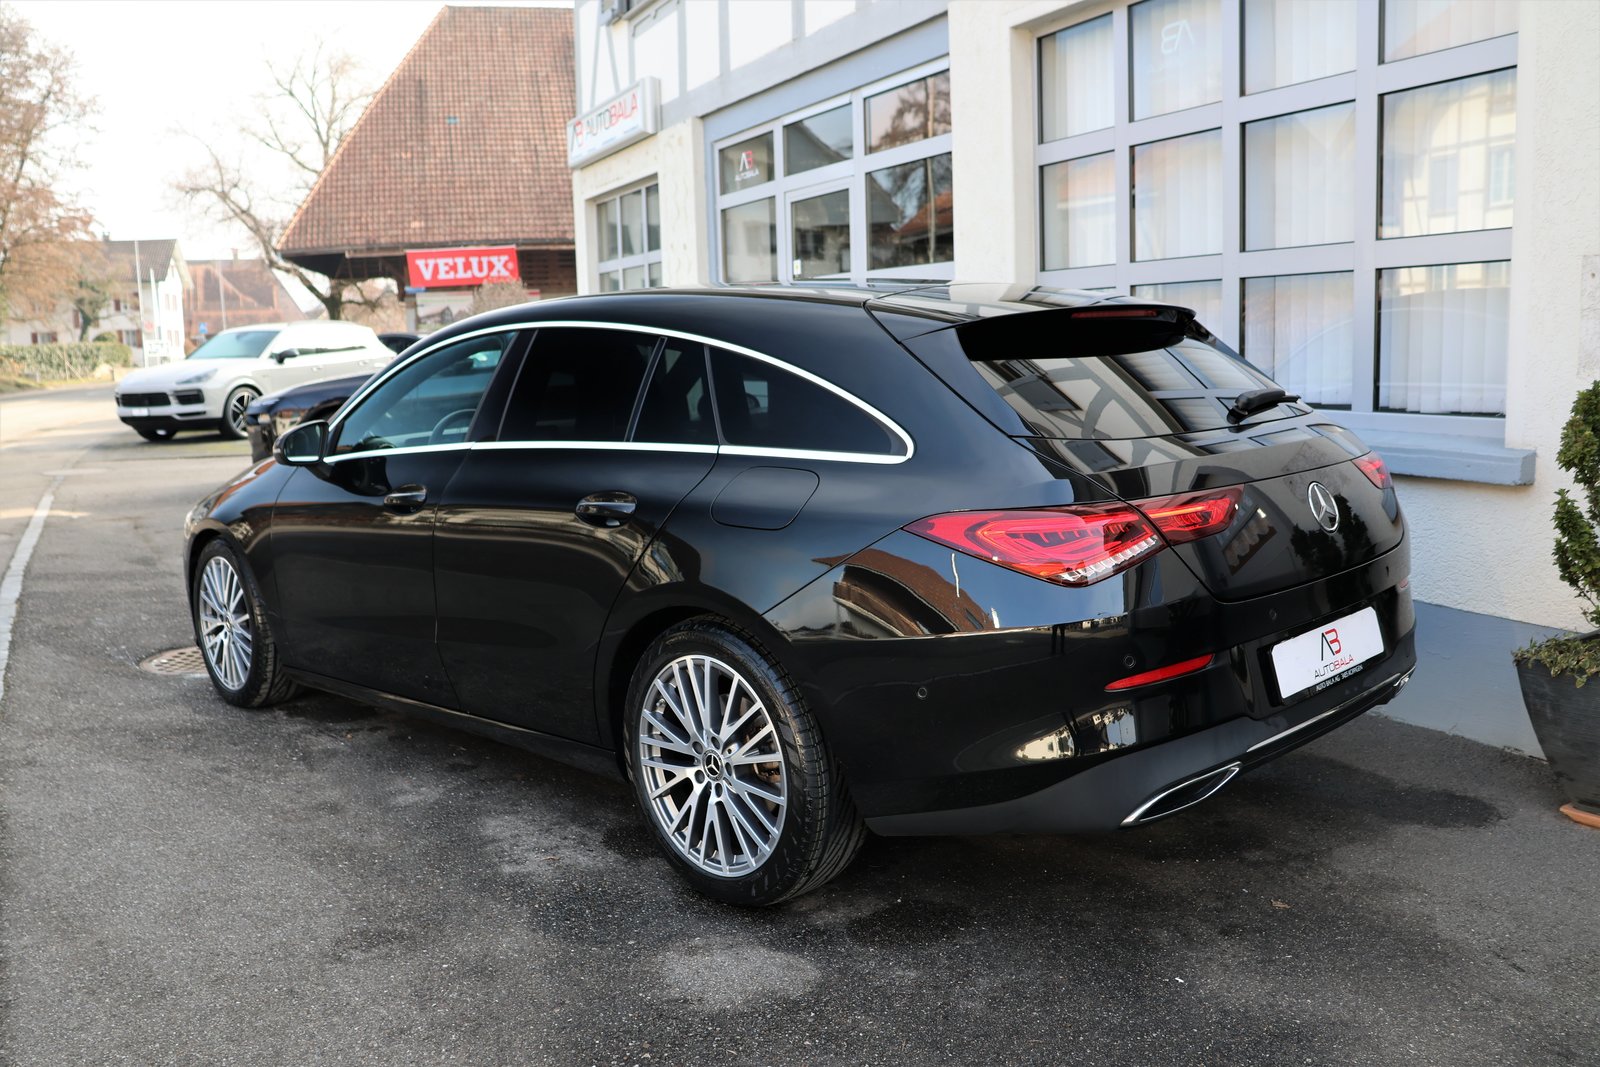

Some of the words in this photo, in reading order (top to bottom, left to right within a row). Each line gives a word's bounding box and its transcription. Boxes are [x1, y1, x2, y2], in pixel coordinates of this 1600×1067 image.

[585, 91, 638, 137] AUTOBALA
[415, 255, 510, 281] VELUX
[1320, 628, 1342, 661] AB
[1314, 654, 1354, 679] AUTOBALA
